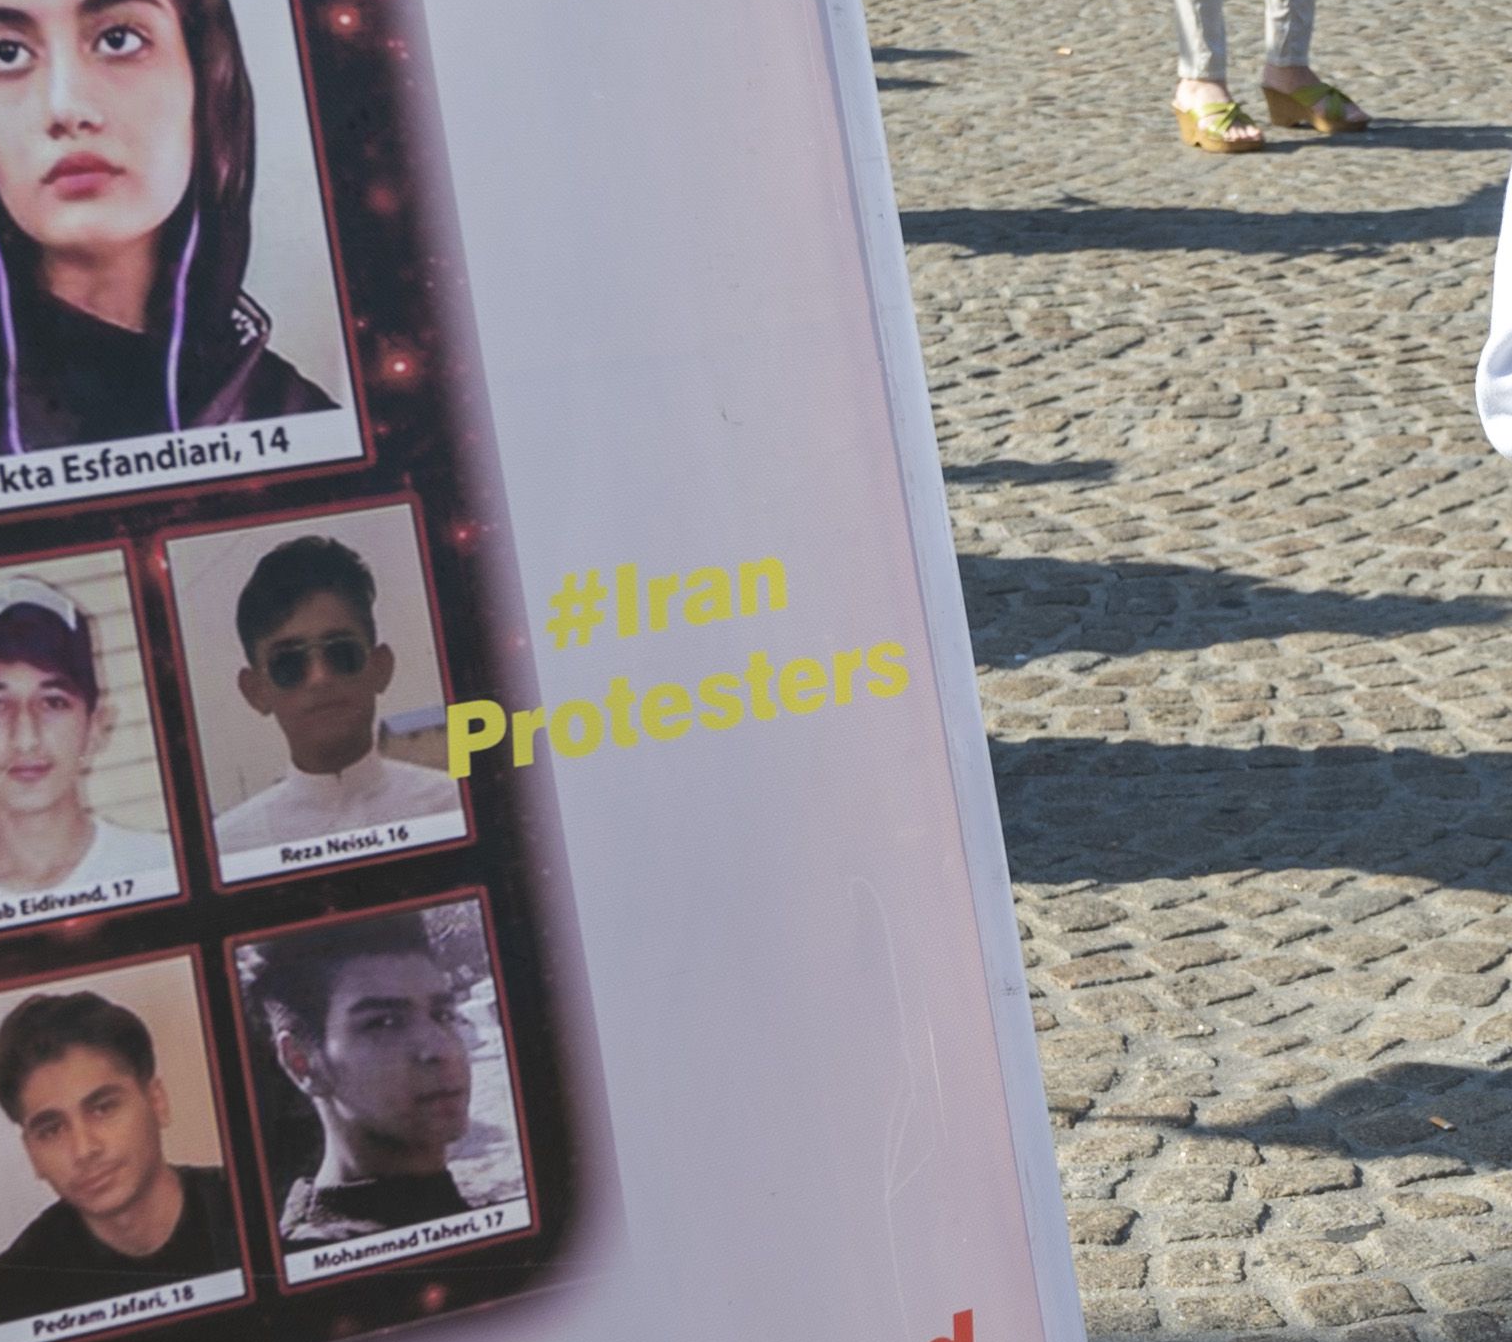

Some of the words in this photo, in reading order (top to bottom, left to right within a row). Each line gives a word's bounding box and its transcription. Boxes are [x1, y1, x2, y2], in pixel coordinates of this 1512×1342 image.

[61, 432, 241, 494] Esfandiari,
[248, 425, 291, 457] 14
[545, 556, 789, 650] #Iran
[446, 641, 911, 780] Protesters
[280, 840, 323, 864] Reza
[326, 830, 384, 856] Neissi,
[386, 827, 410, 844] 16
[20, 886, 108, 916] Eidivand,
[112, 880, 135, 899] 17
[313, 1233, 419, 1271] Mohammad
[422, 1219, 480, 1247] Taheri,
[483, 1211, 505, 1230] 17
[32, 1305, 107, 1336] Pedram
[111, 1291, 169, 1322] Jafari,
[171, 1285, 195, 1303] 18
